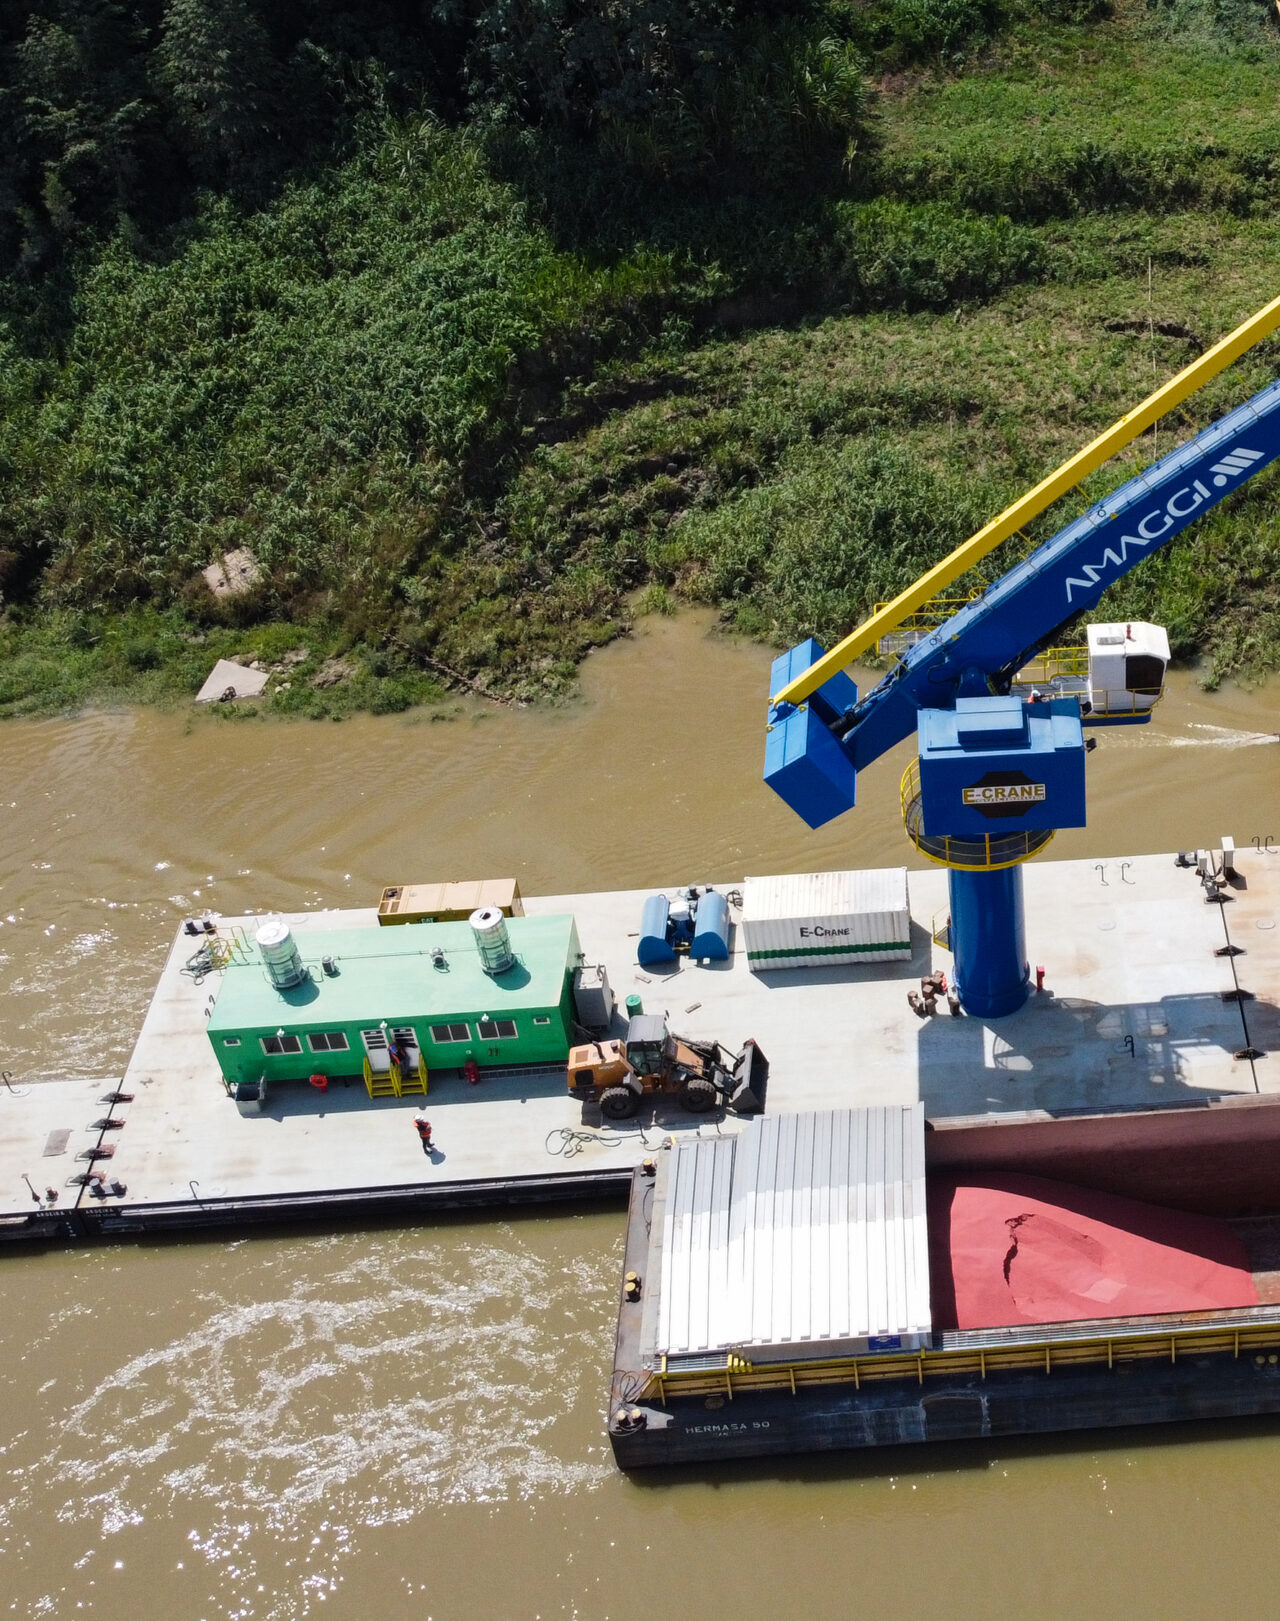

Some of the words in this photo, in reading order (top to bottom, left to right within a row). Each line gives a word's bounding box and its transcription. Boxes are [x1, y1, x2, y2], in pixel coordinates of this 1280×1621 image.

[1065, 479, 1212, 603] AMAGGI
[963, 785, 1044, 803] E-CRANE
[685, 1423, 747, 1434] HERMASA
[752, 1420, 770, 1429] 50
